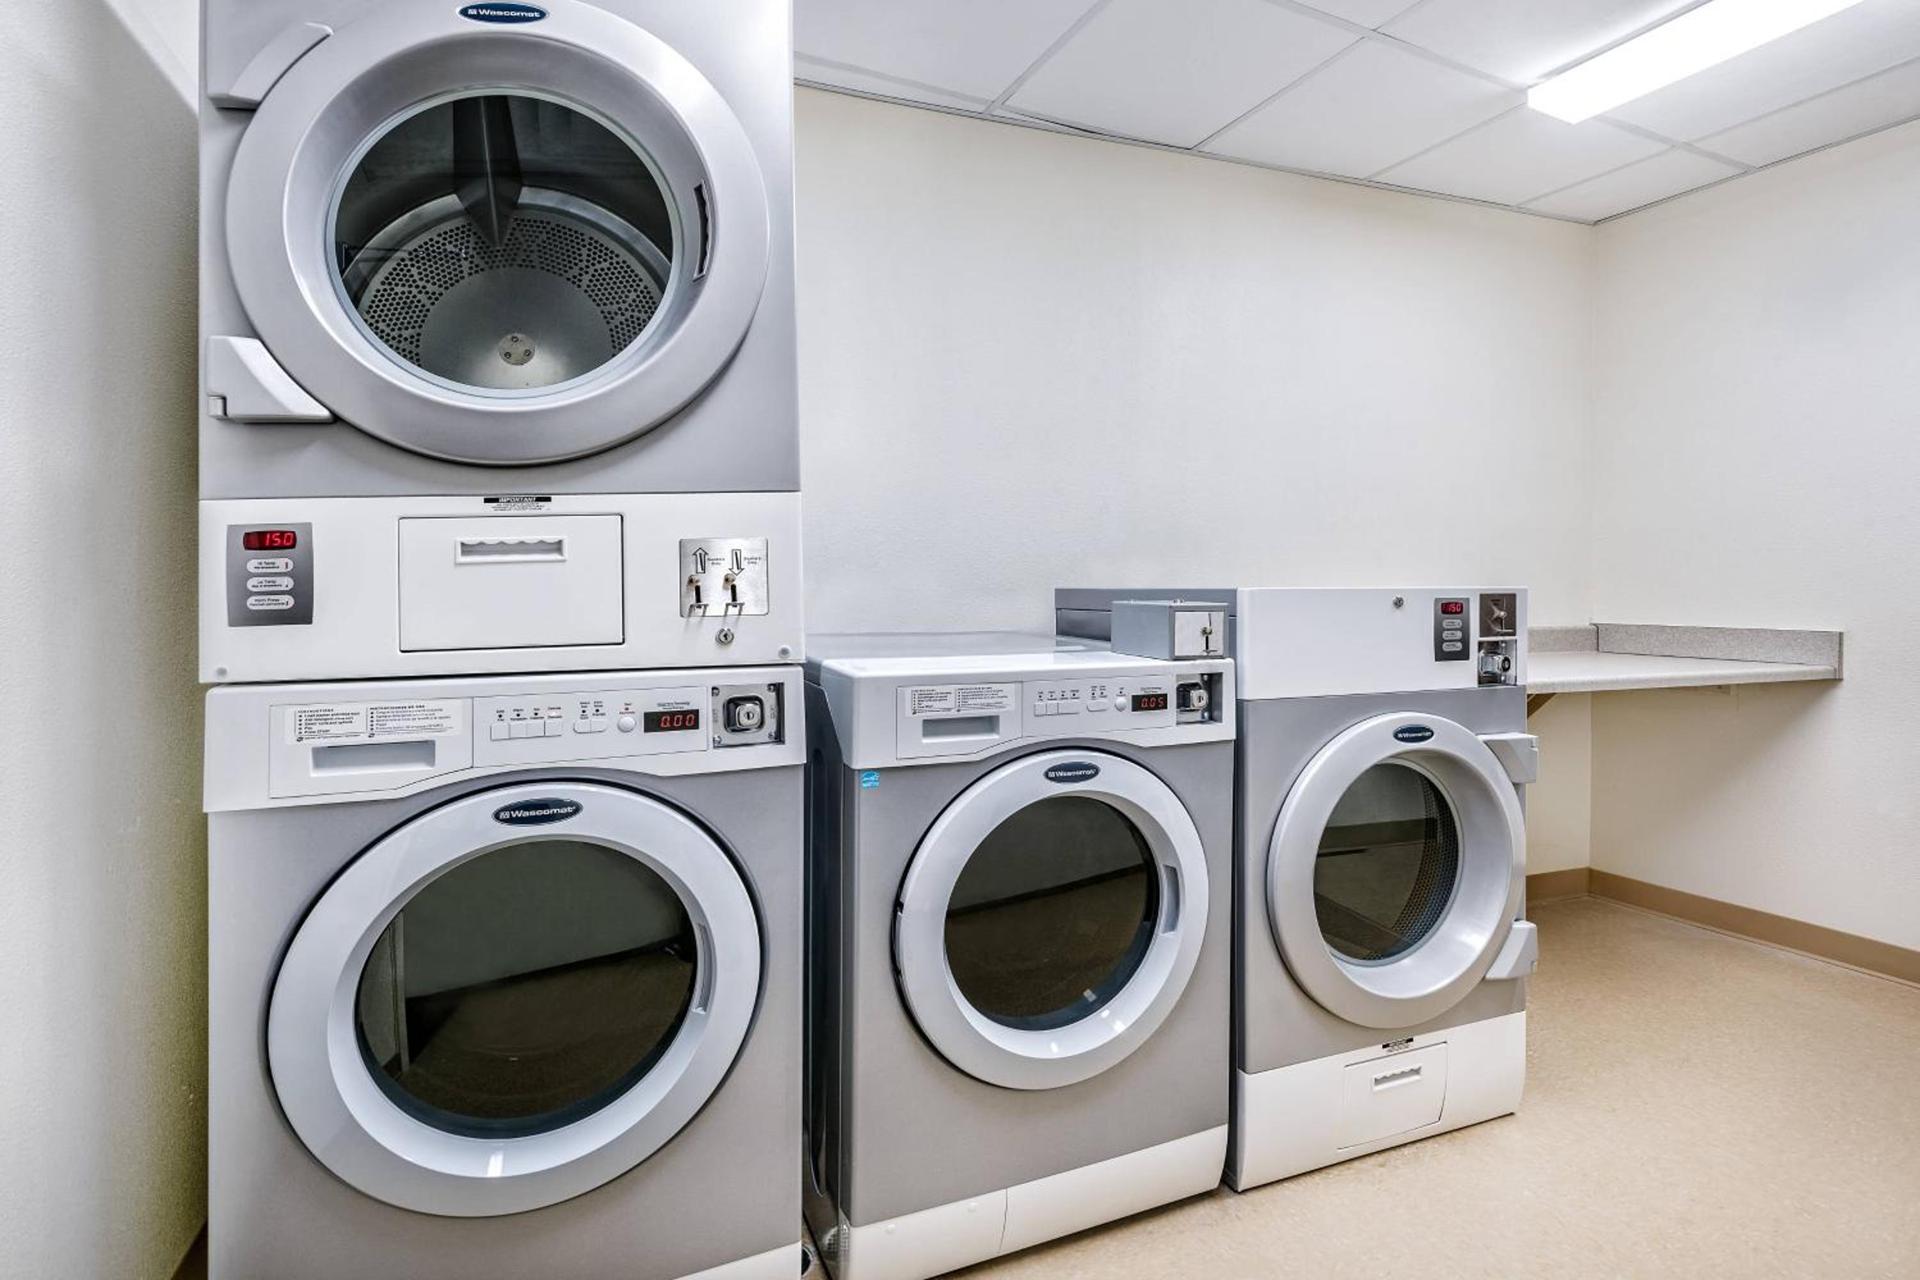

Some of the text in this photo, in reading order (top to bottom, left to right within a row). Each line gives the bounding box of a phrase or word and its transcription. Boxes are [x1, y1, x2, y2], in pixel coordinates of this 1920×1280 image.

[479, 8, 541, 18] Wascomat
[265, 532, 294, 546] 150
[511, 806, 574, 818] Wascomat
